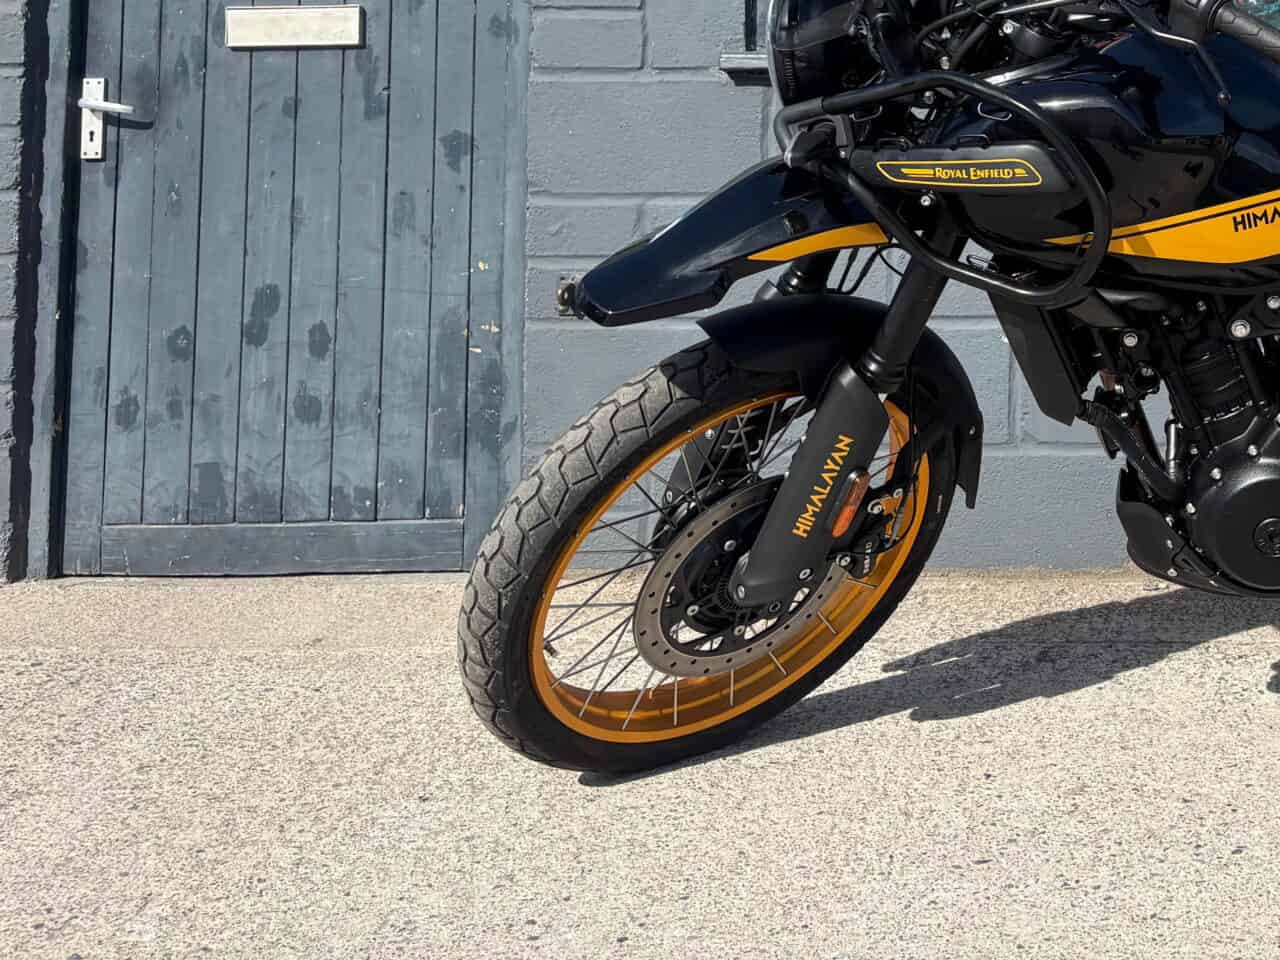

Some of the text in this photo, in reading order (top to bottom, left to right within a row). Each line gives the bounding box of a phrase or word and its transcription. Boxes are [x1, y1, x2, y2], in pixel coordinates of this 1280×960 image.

[935, 167, 1013, 180] ROYAL ENFIELD
[791, 434, 855, 539] HIMALAYAN
